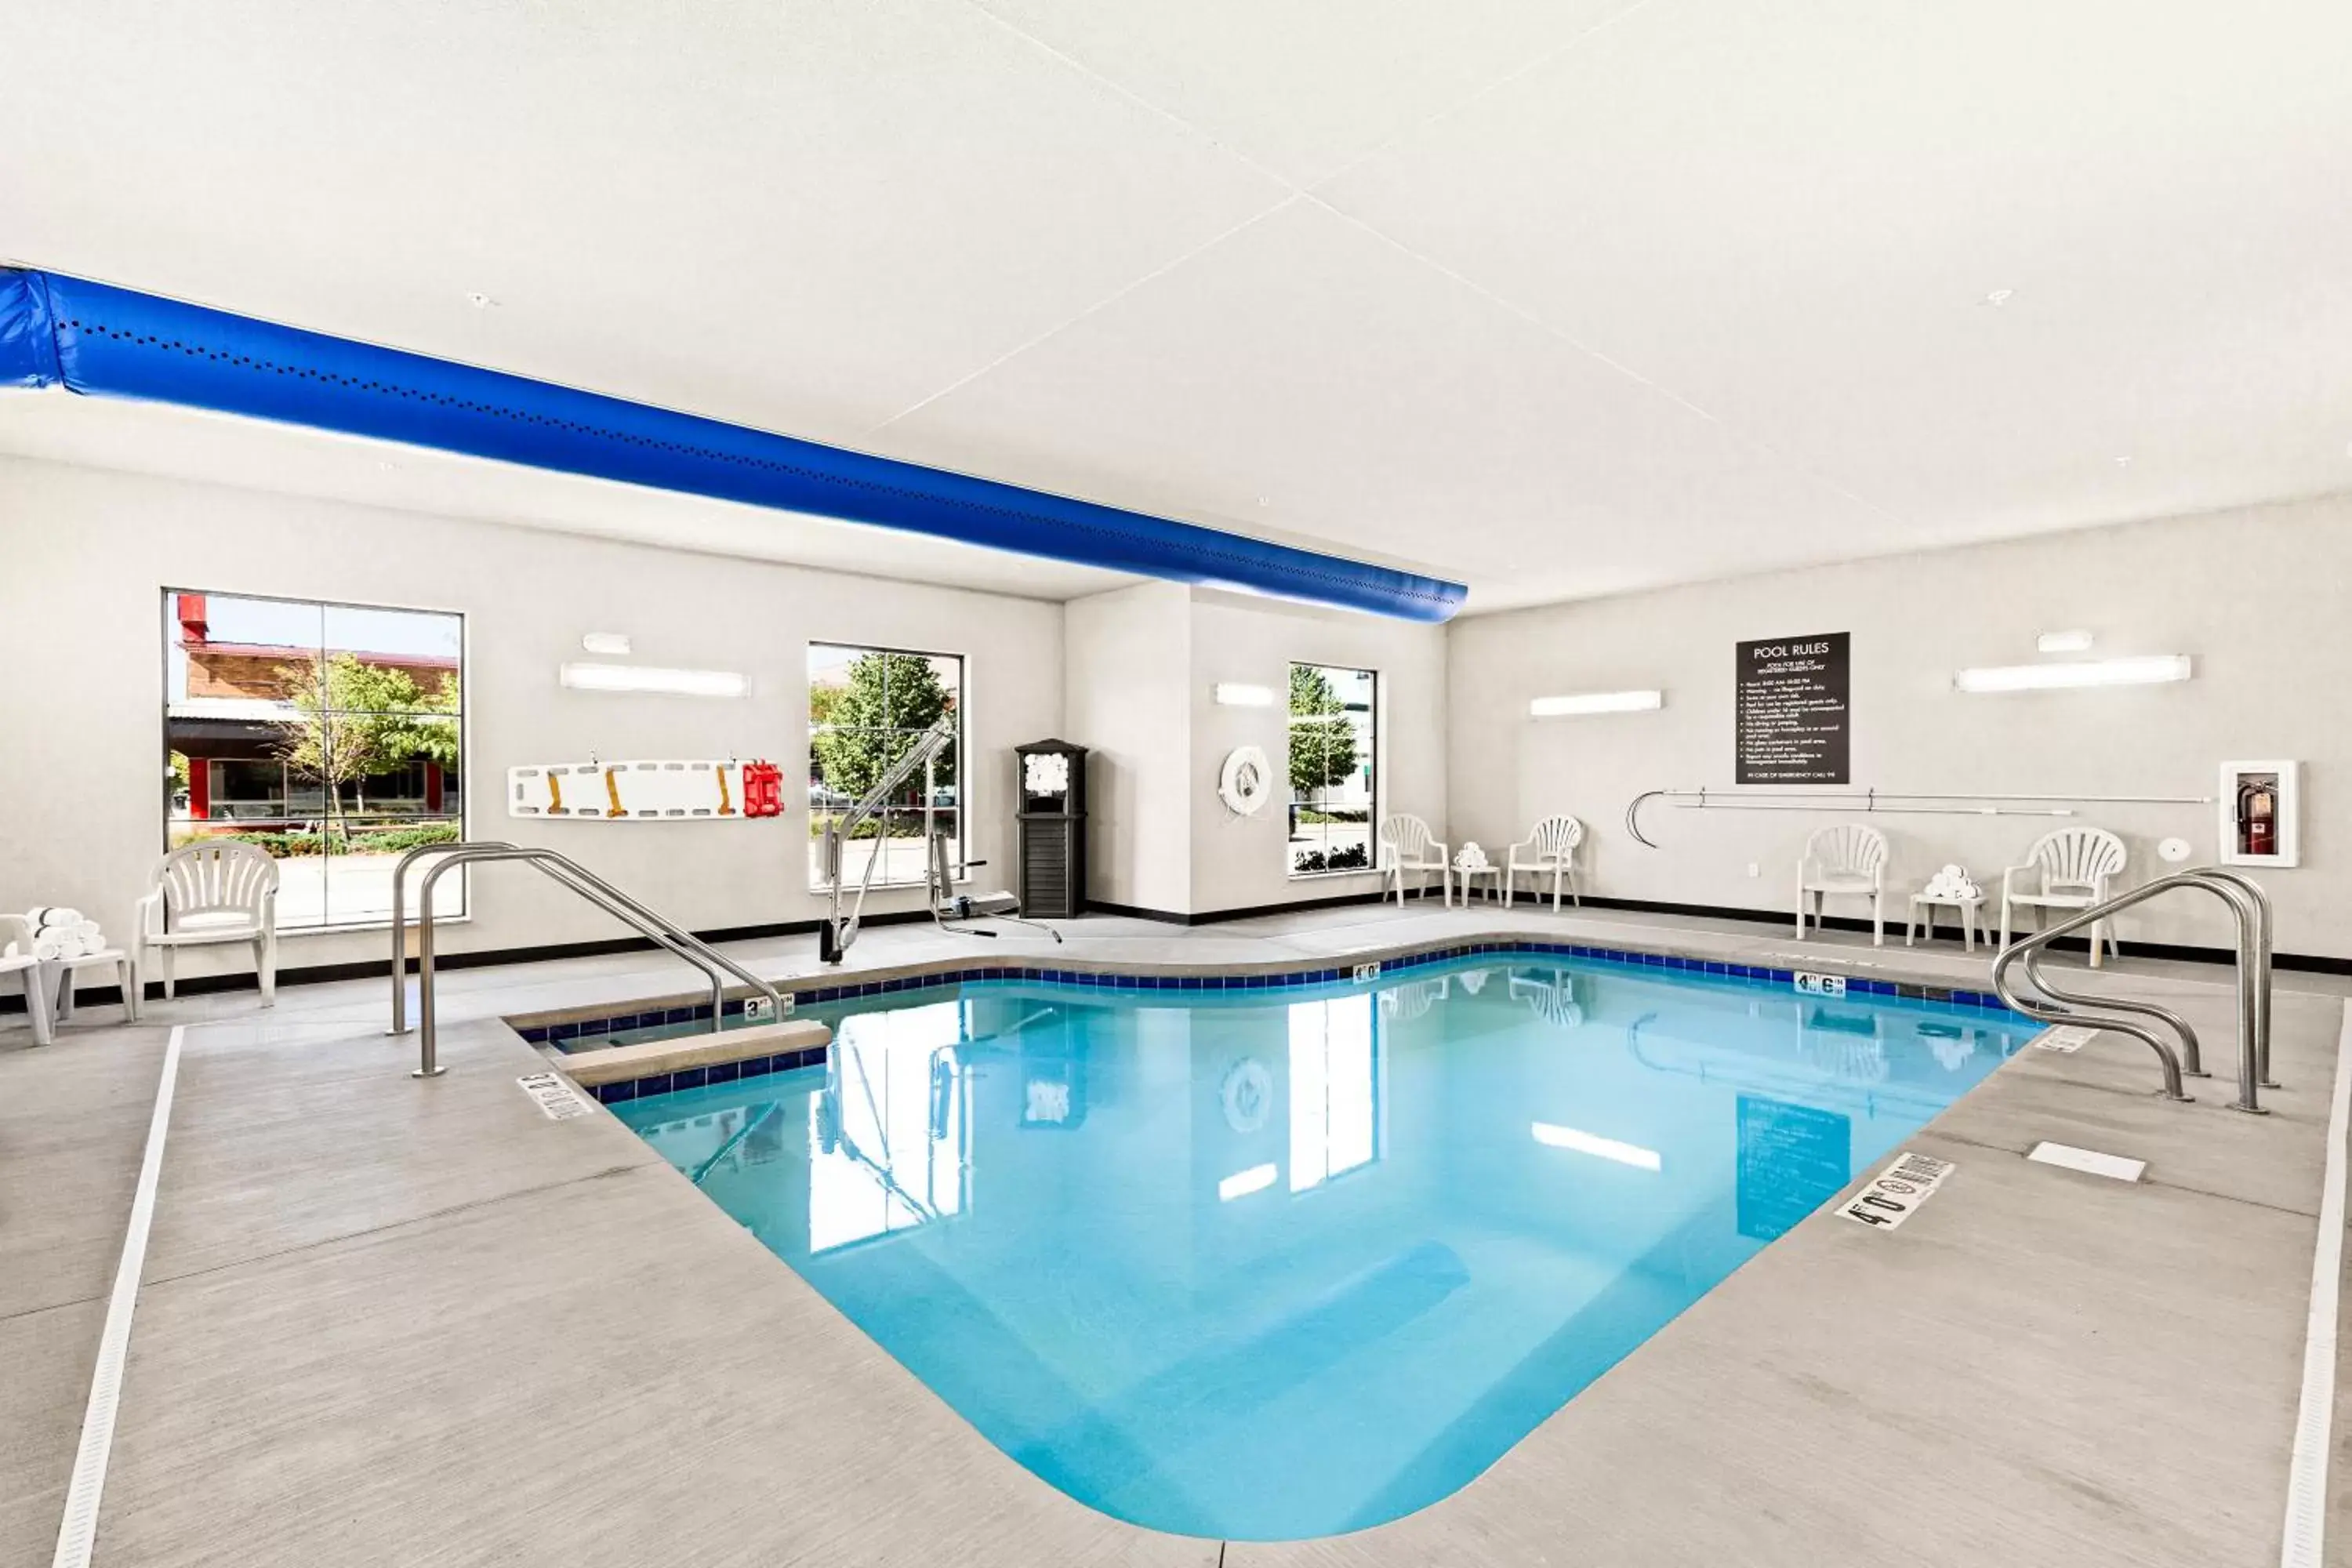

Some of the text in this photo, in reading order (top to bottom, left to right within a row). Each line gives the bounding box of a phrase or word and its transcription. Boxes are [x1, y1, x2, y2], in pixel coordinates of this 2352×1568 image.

[1754, 642, 1829, 659] POOL RULES
[1798, 975, 1808, 990] 4
[747, 1001, 758, 1017] 3
[1862, 1196, 1906, 1212] 0
[1848, 1209, 1892, 1225] 4
